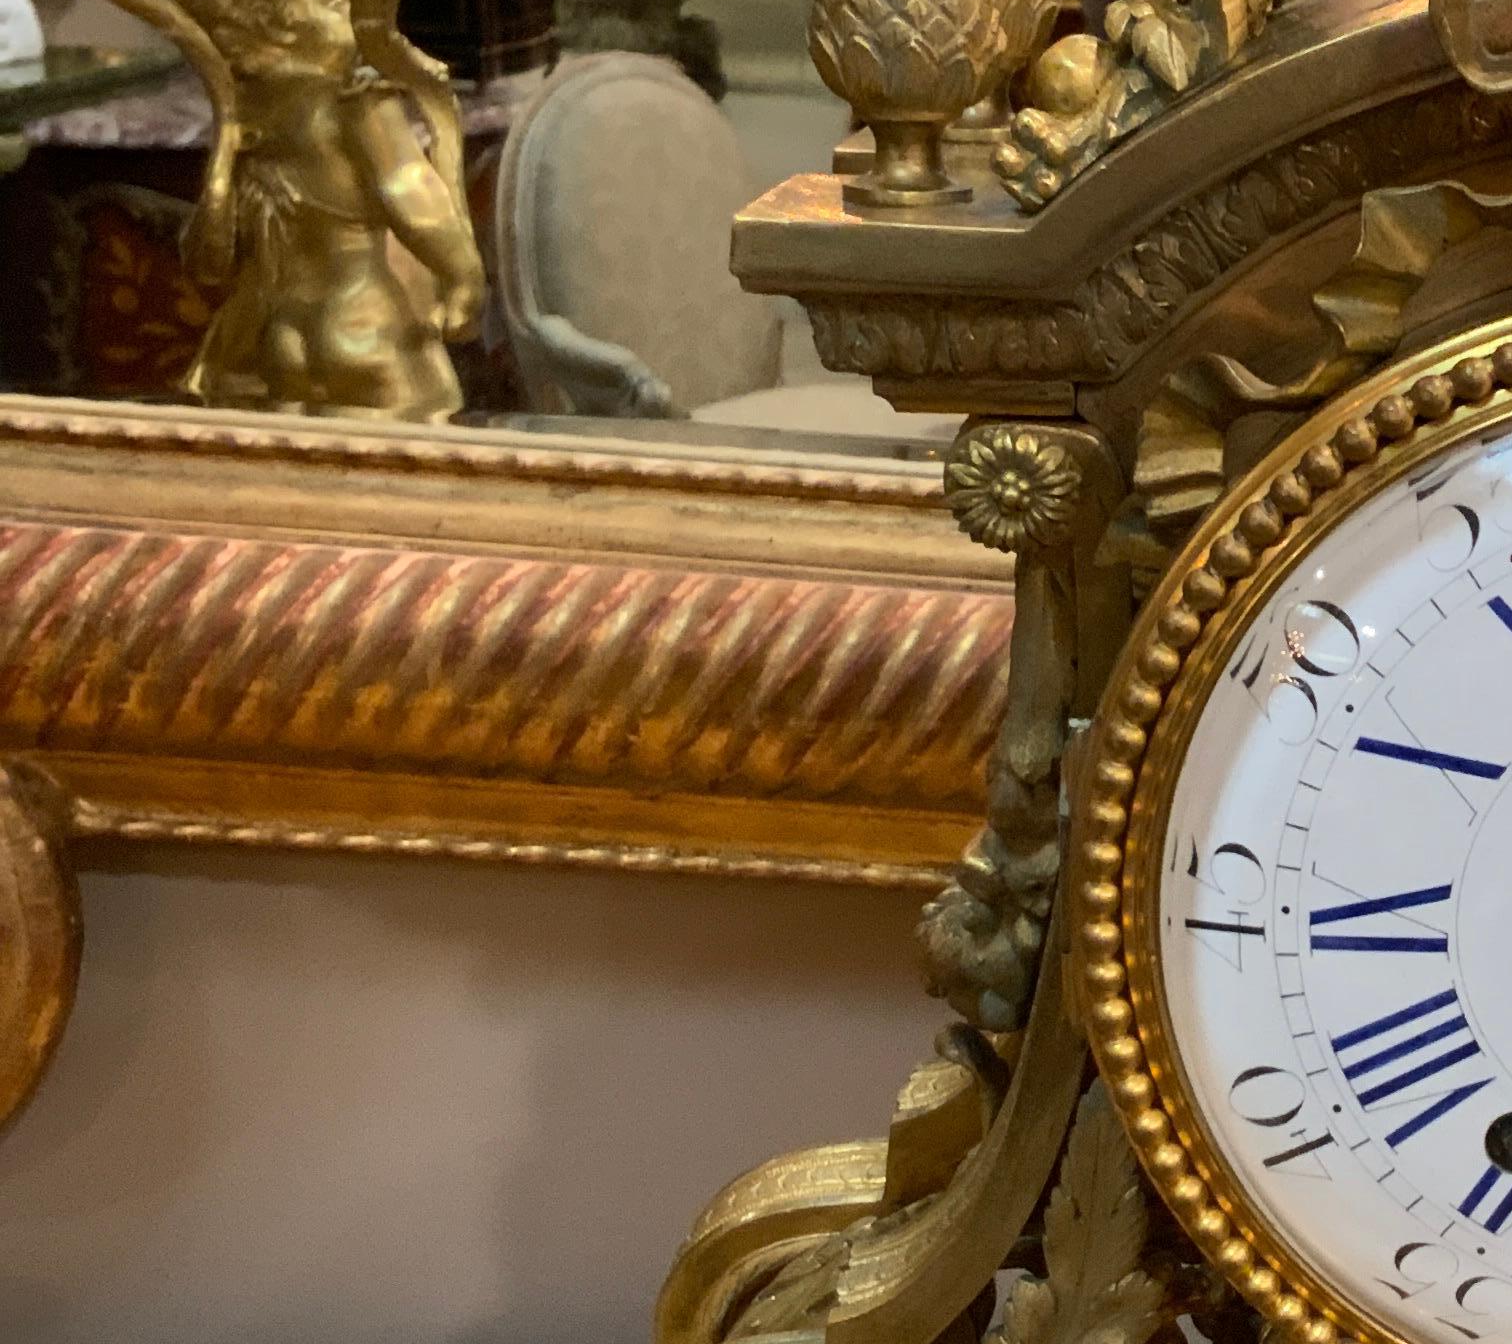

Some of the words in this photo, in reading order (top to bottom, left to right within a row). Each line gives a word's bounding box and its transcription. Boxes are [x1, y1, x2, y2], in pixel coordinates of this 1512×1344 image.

[1350, 686, 1511, 826] X
[1185, 833, 1266, 973] 45
[1228, 1066, 1338, 1180] 40
[1327, 980, 1497, 1154] VIII
